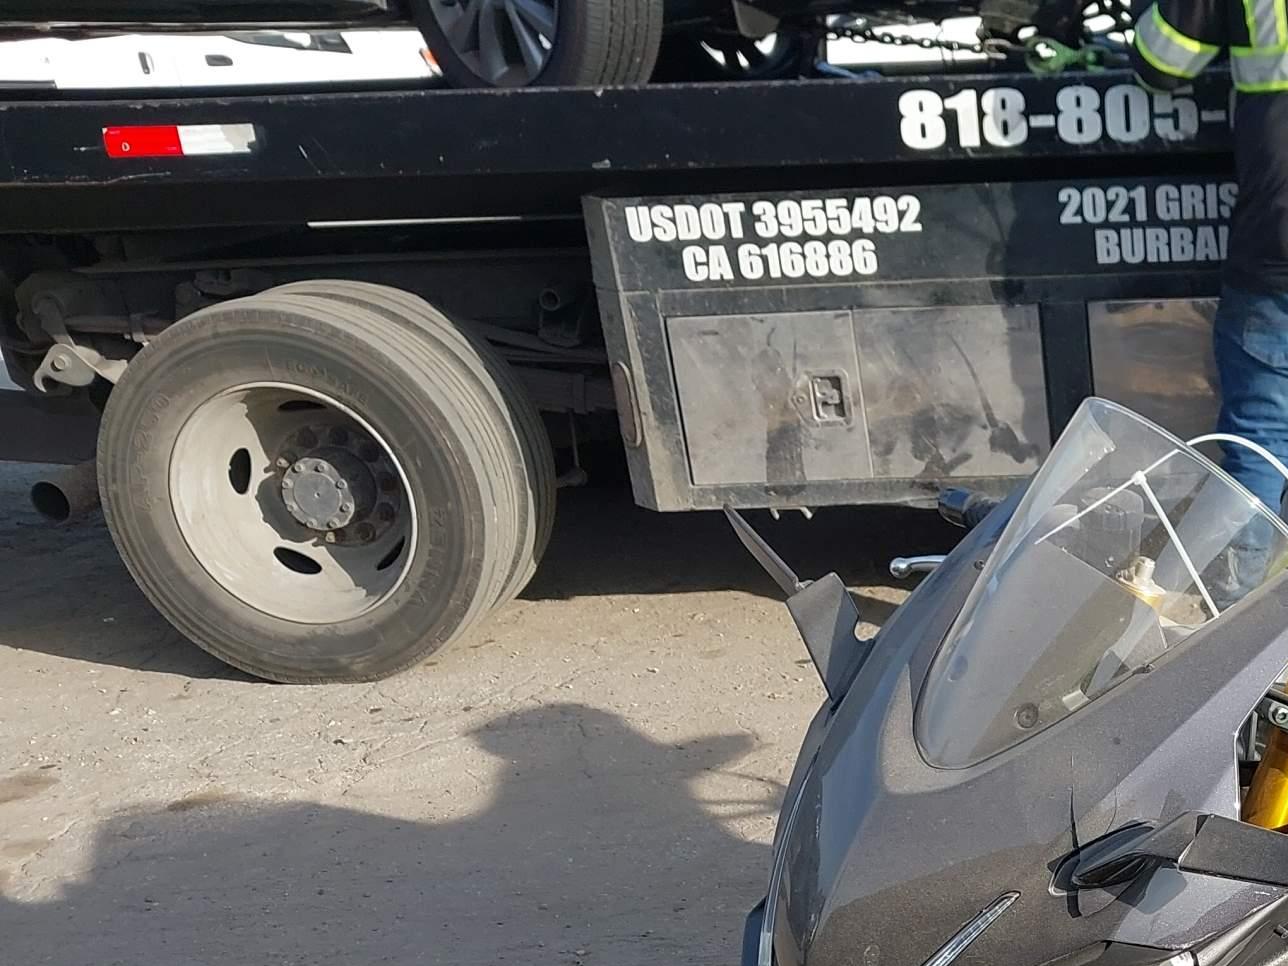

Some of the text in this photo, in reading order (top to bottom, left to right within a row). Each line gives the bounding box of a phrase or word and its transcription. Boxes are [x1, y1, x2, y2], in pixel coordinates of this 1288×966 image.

[899, 84, 1235, 149] 818-805-
[624, 195, 923, 243] USDOT 3955492
[1058, 185, 1149, 224] 2021
[682, 239, 878, 282] CA 616886
